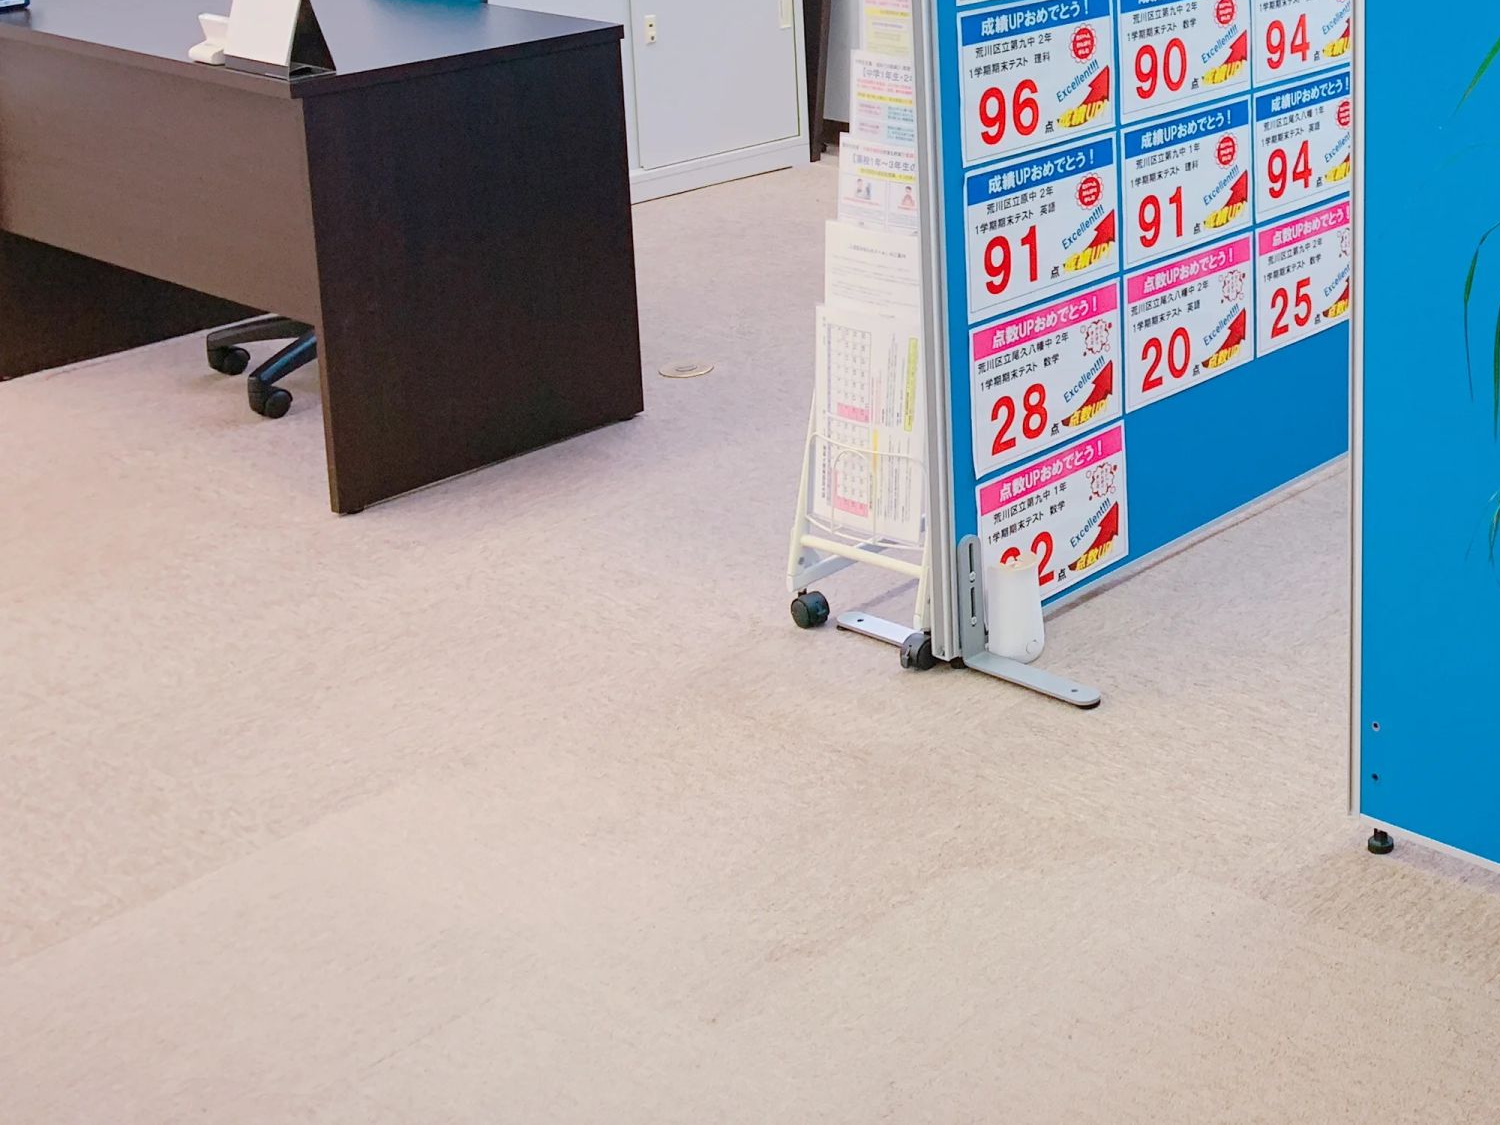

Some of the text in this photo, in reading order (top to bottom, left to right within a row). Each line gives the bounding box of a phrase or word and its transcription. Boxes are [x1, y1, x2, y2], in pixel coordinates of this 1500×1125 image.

[1134, 37, 1188, 100] 90
[1265, 14, 1310, 70] 94
[978, 78, 1040, 147] 96
[1267, 140, 1313, 199] 94
[1137, 186, 1184, 248] 91
[983, 225, 1039, 295] 91
[1270, 276, 1313, 339] 25
[1141, 326, 1191, 393] 20
[991, 382, 1049, 457] 28
